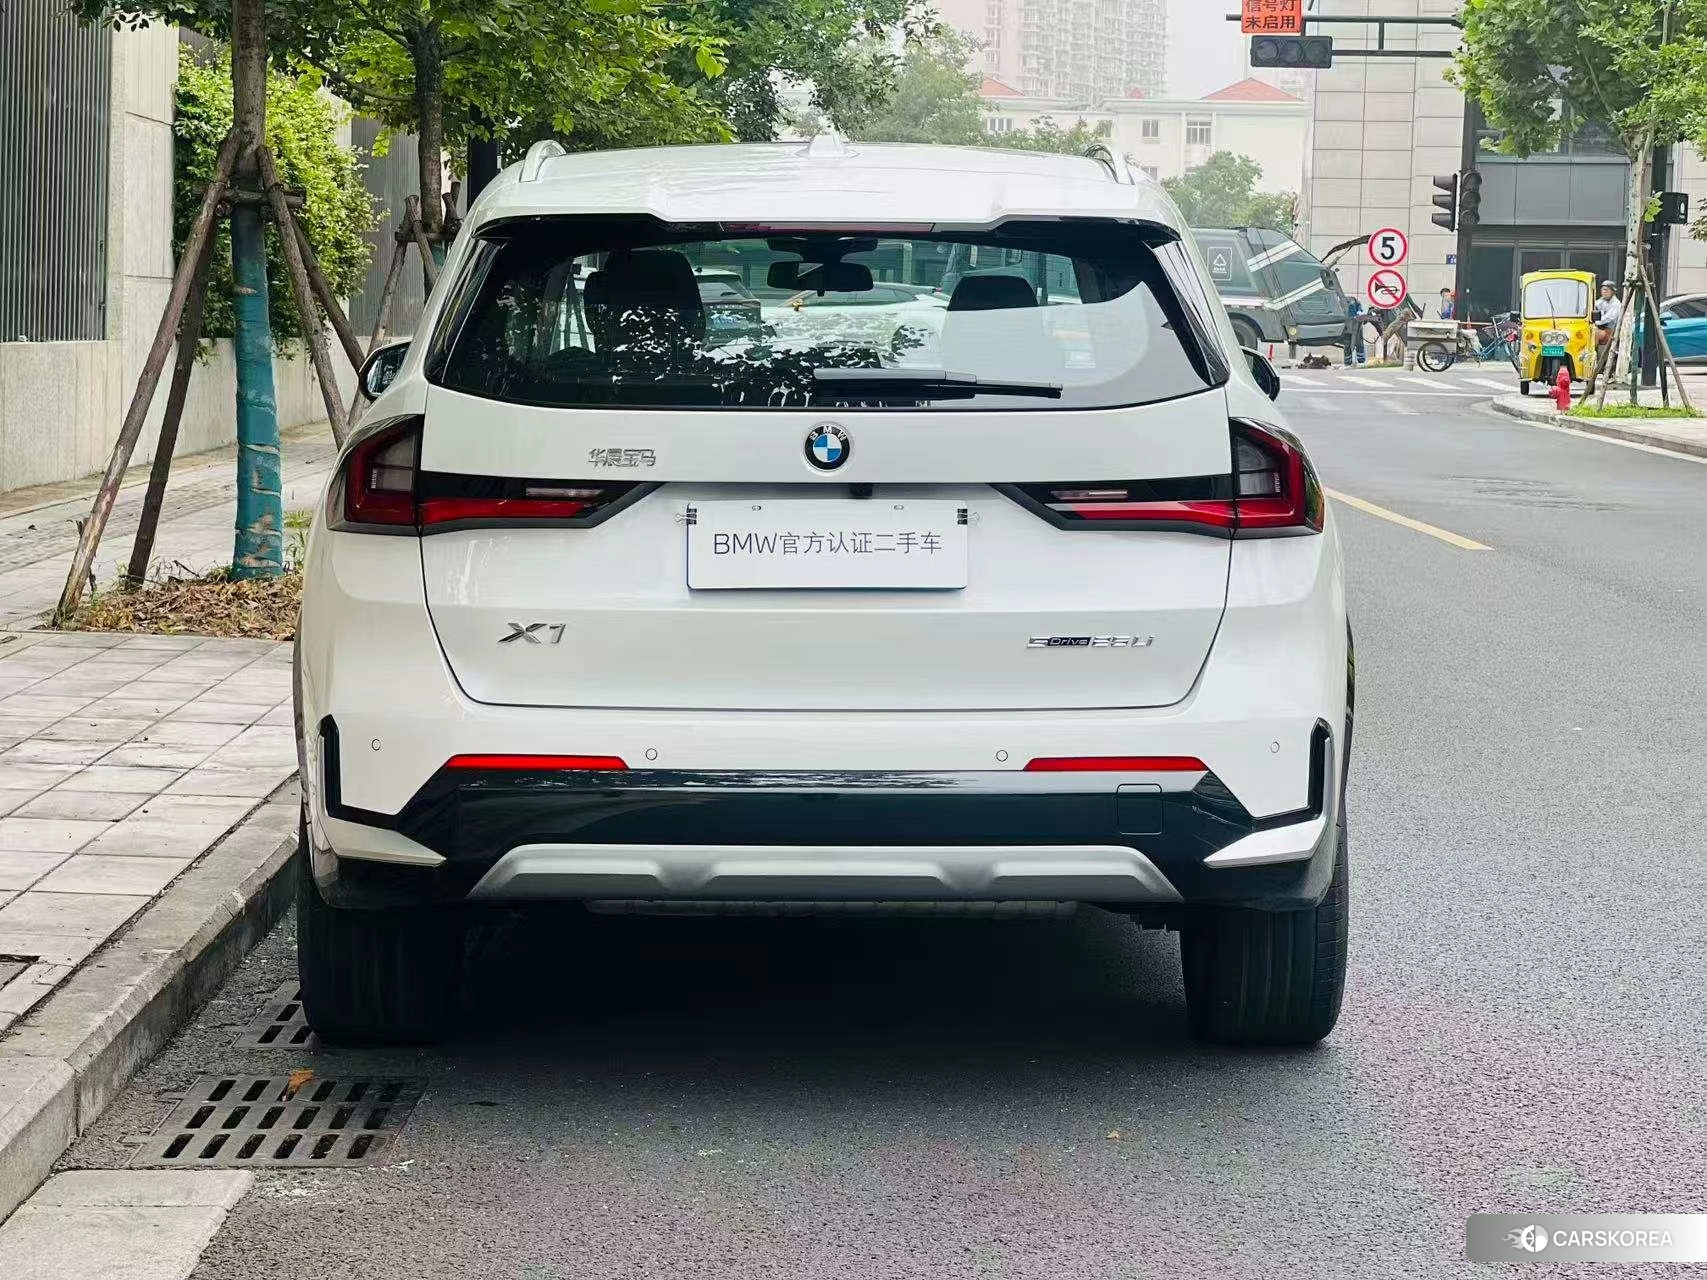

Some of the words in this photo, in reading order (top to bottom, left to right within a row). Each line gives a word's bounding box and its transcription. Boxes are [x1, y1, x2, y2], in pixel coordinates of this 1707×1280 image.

[1245, 15, 1295, 29] 未启用
[1381, 236, 1395, 260] 5
[809, 425, 847, 441] BMW
[588, 448, 656, 467] 华晨宝马
[714, 531, 942, 555] BMW官方认证二手车
[498, 622, 566, 644] X1
